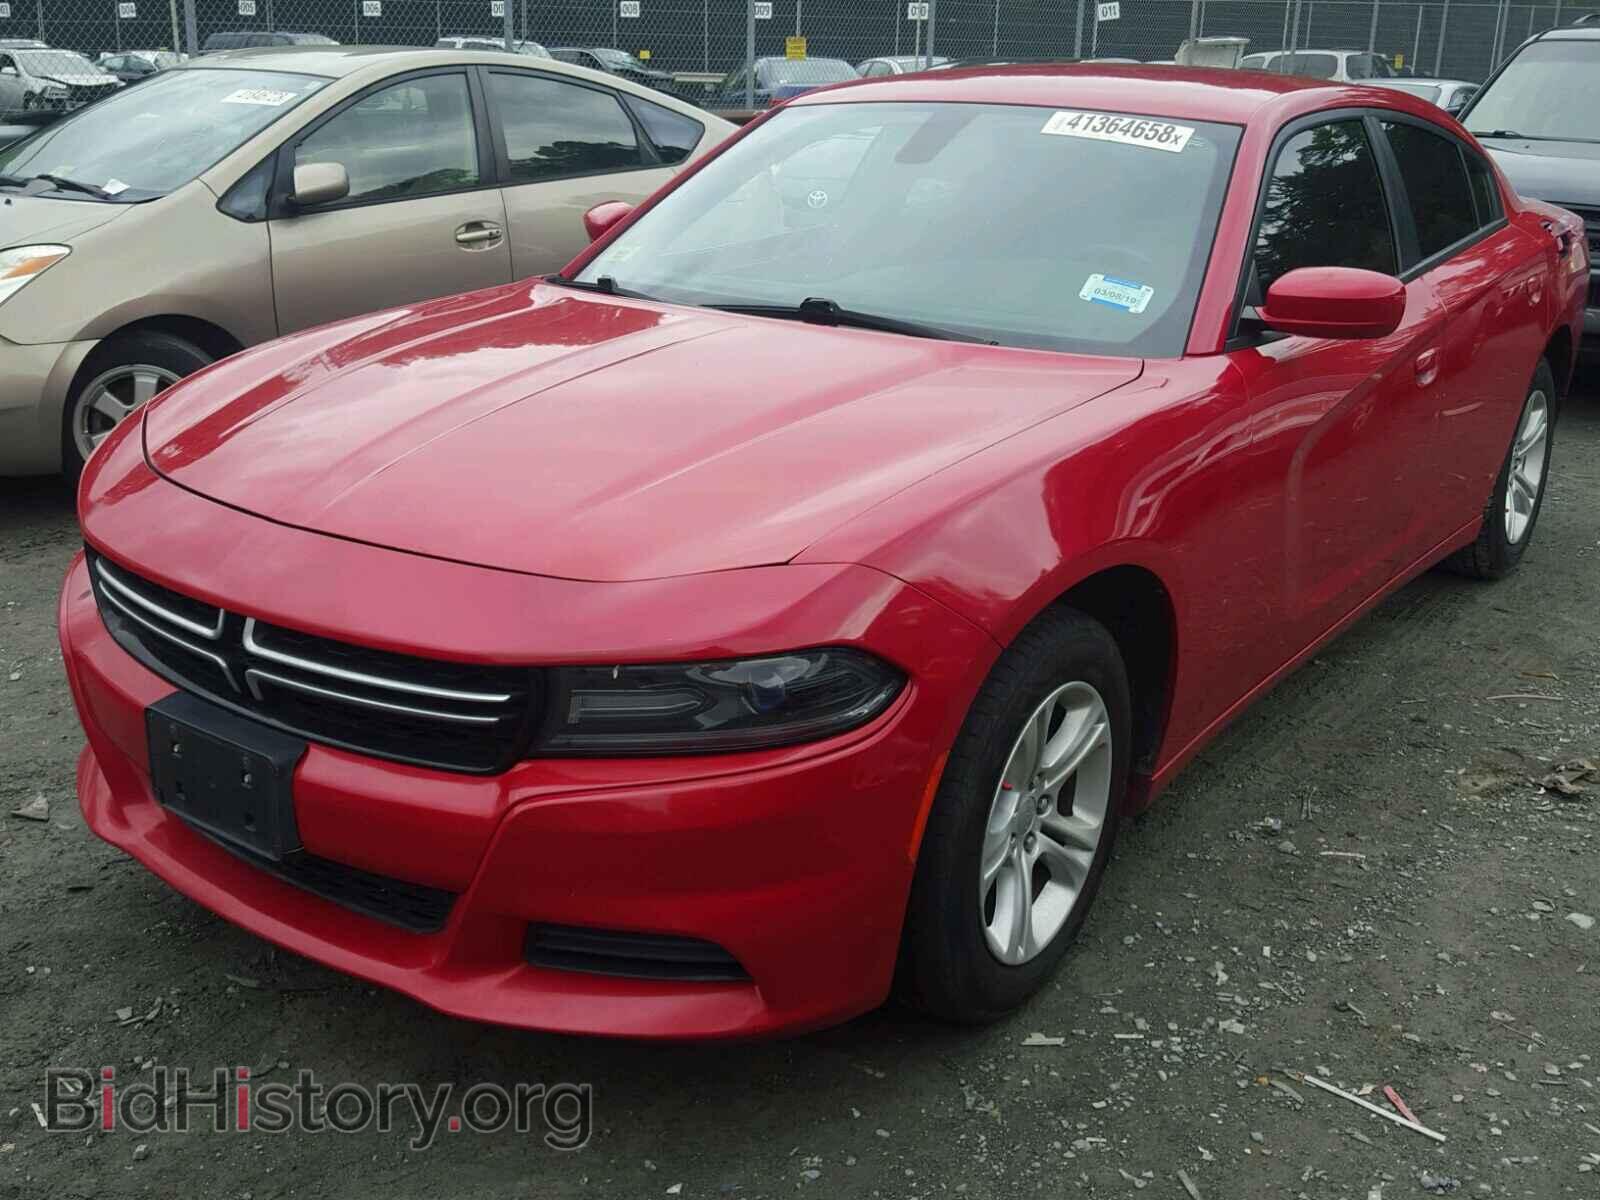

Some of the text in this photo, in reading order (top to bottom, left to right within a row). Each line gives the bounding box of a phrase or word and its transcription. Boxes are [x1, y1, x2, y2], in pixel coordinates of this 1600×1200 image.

[121, 4, 135, 15] 004
[365, 3, 380, 14] 006
[622, 3, 638, 14] 008
[1101, 6, 1117, 17] 011
